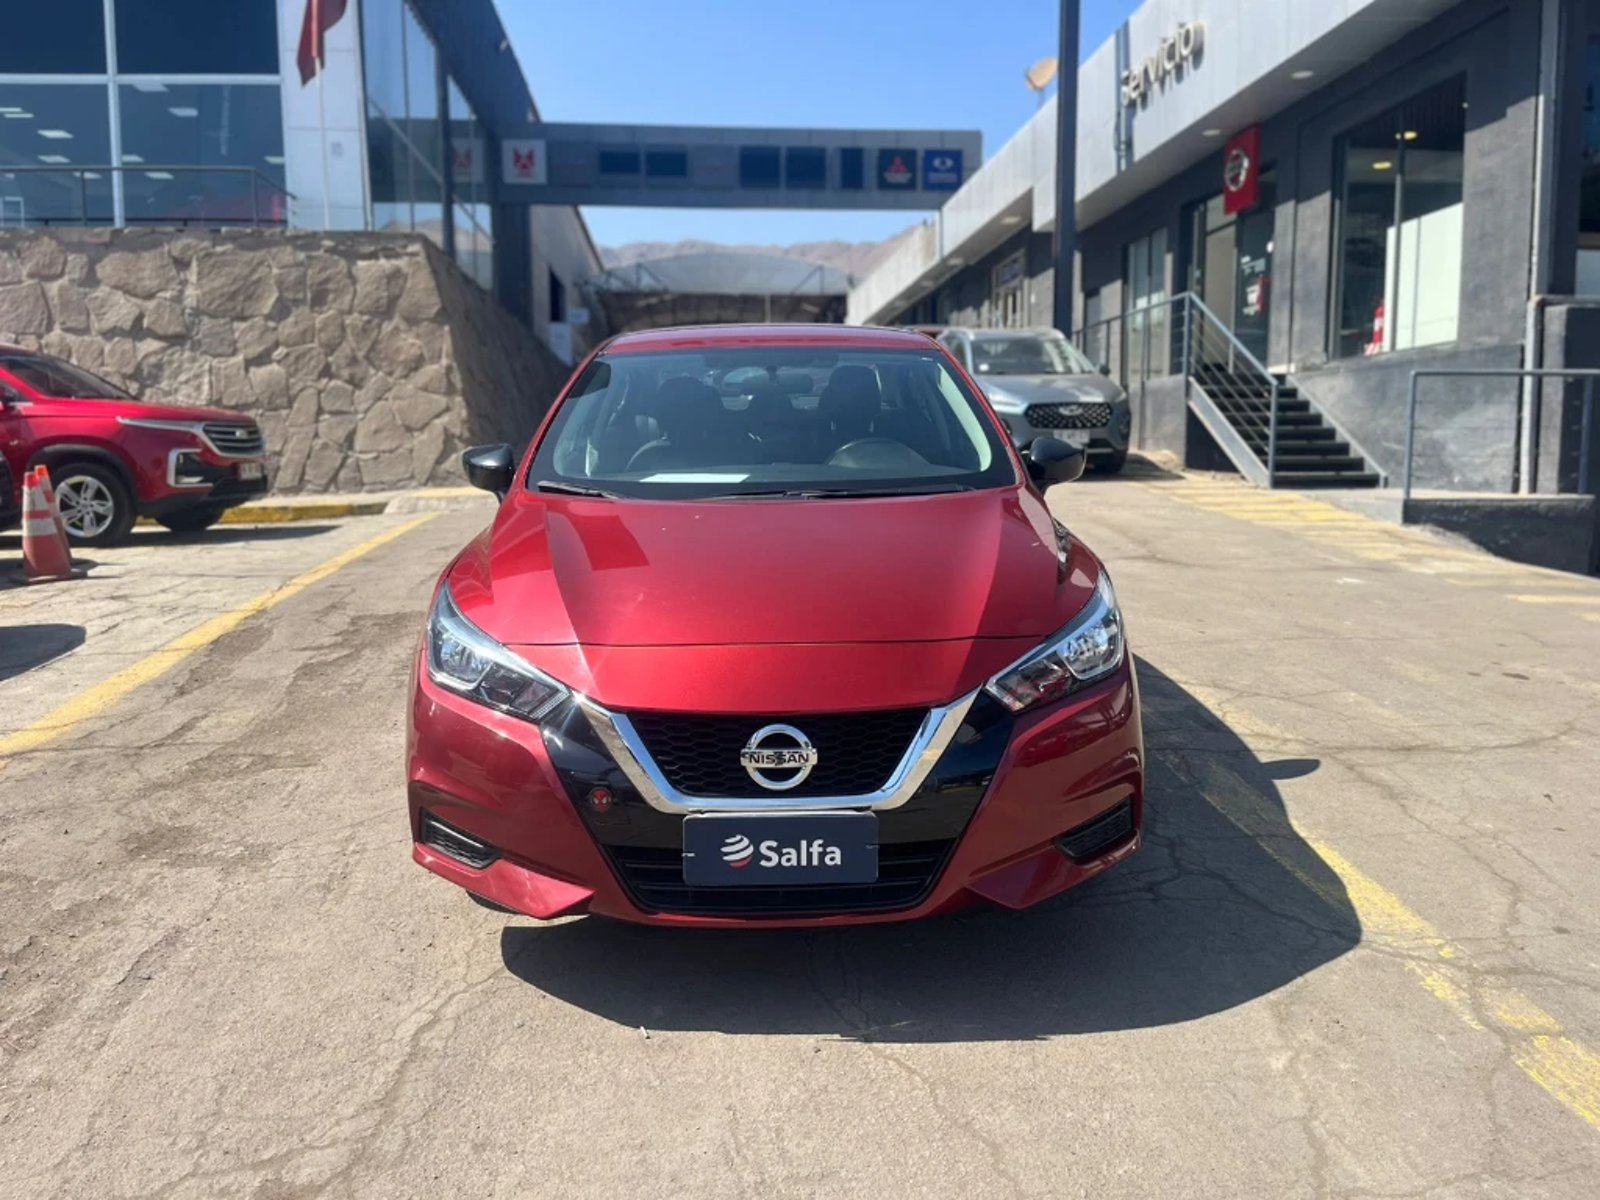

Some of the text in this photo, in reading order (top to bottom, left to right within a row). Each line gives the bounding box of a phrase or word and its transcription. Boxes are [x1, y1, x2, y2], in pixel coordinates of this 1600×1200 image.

[1121, 22, 1200, 107] servicio
[749, 752, 809, 765] NISSAN
[758, 839, 842, 868] Salfa
